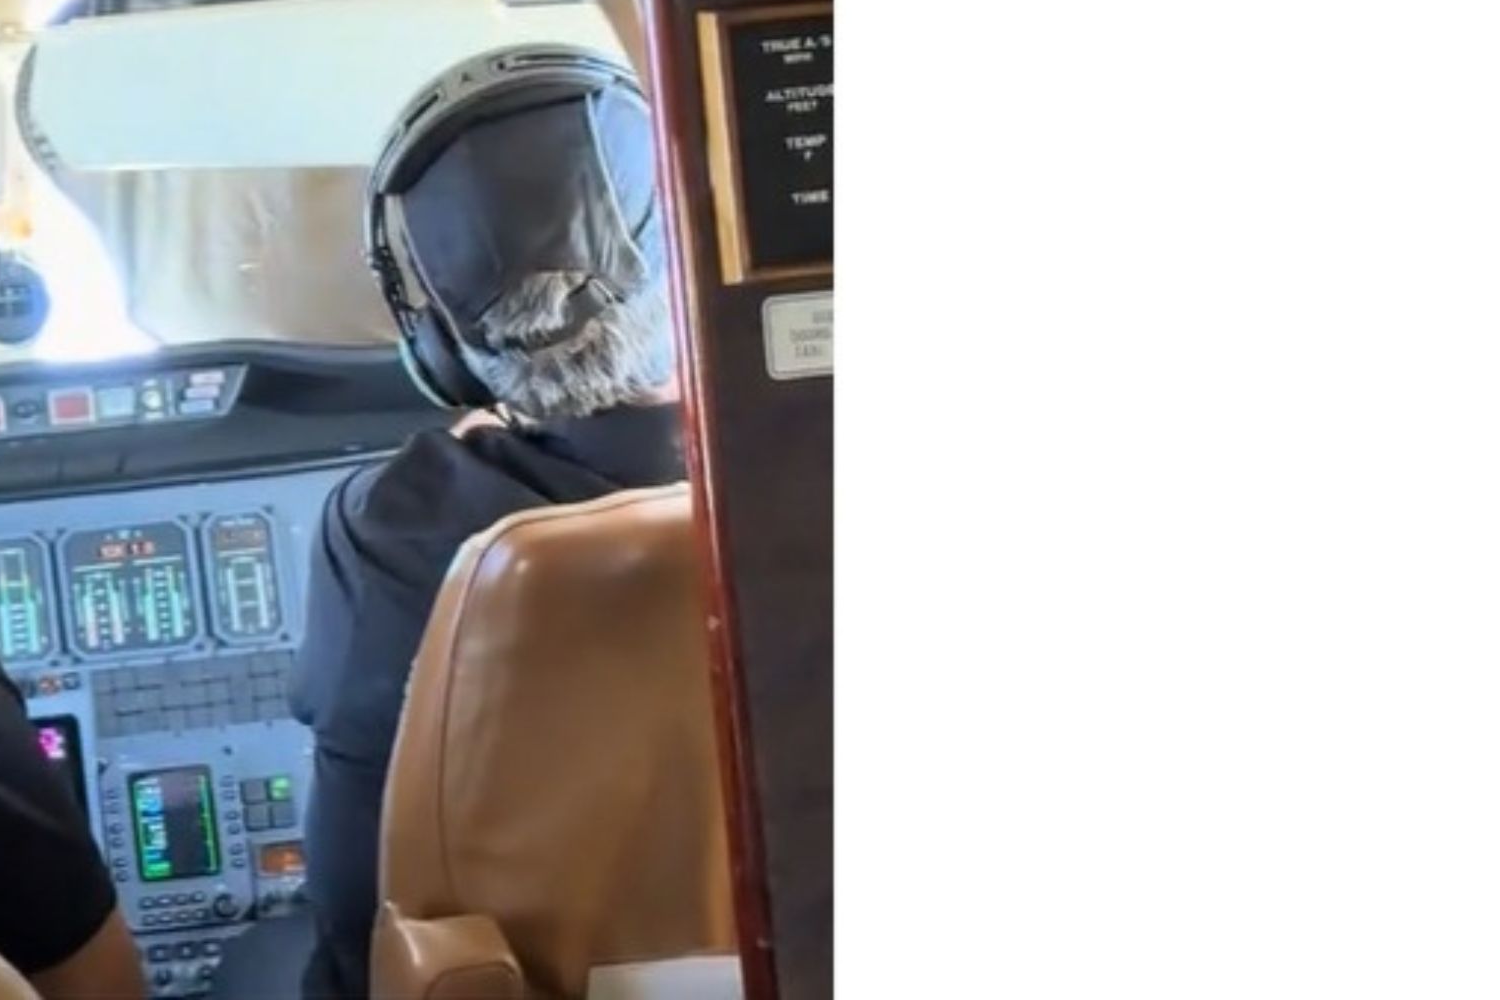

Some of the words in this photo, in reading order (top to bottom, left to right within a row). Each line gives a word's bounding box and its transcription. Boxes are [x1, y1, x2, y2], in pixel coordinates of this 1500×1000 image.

[761, 38, 802, 54] TRUE
[785, 133, 827, 150] TEMP
[791, 189, 829, 205] TIME
